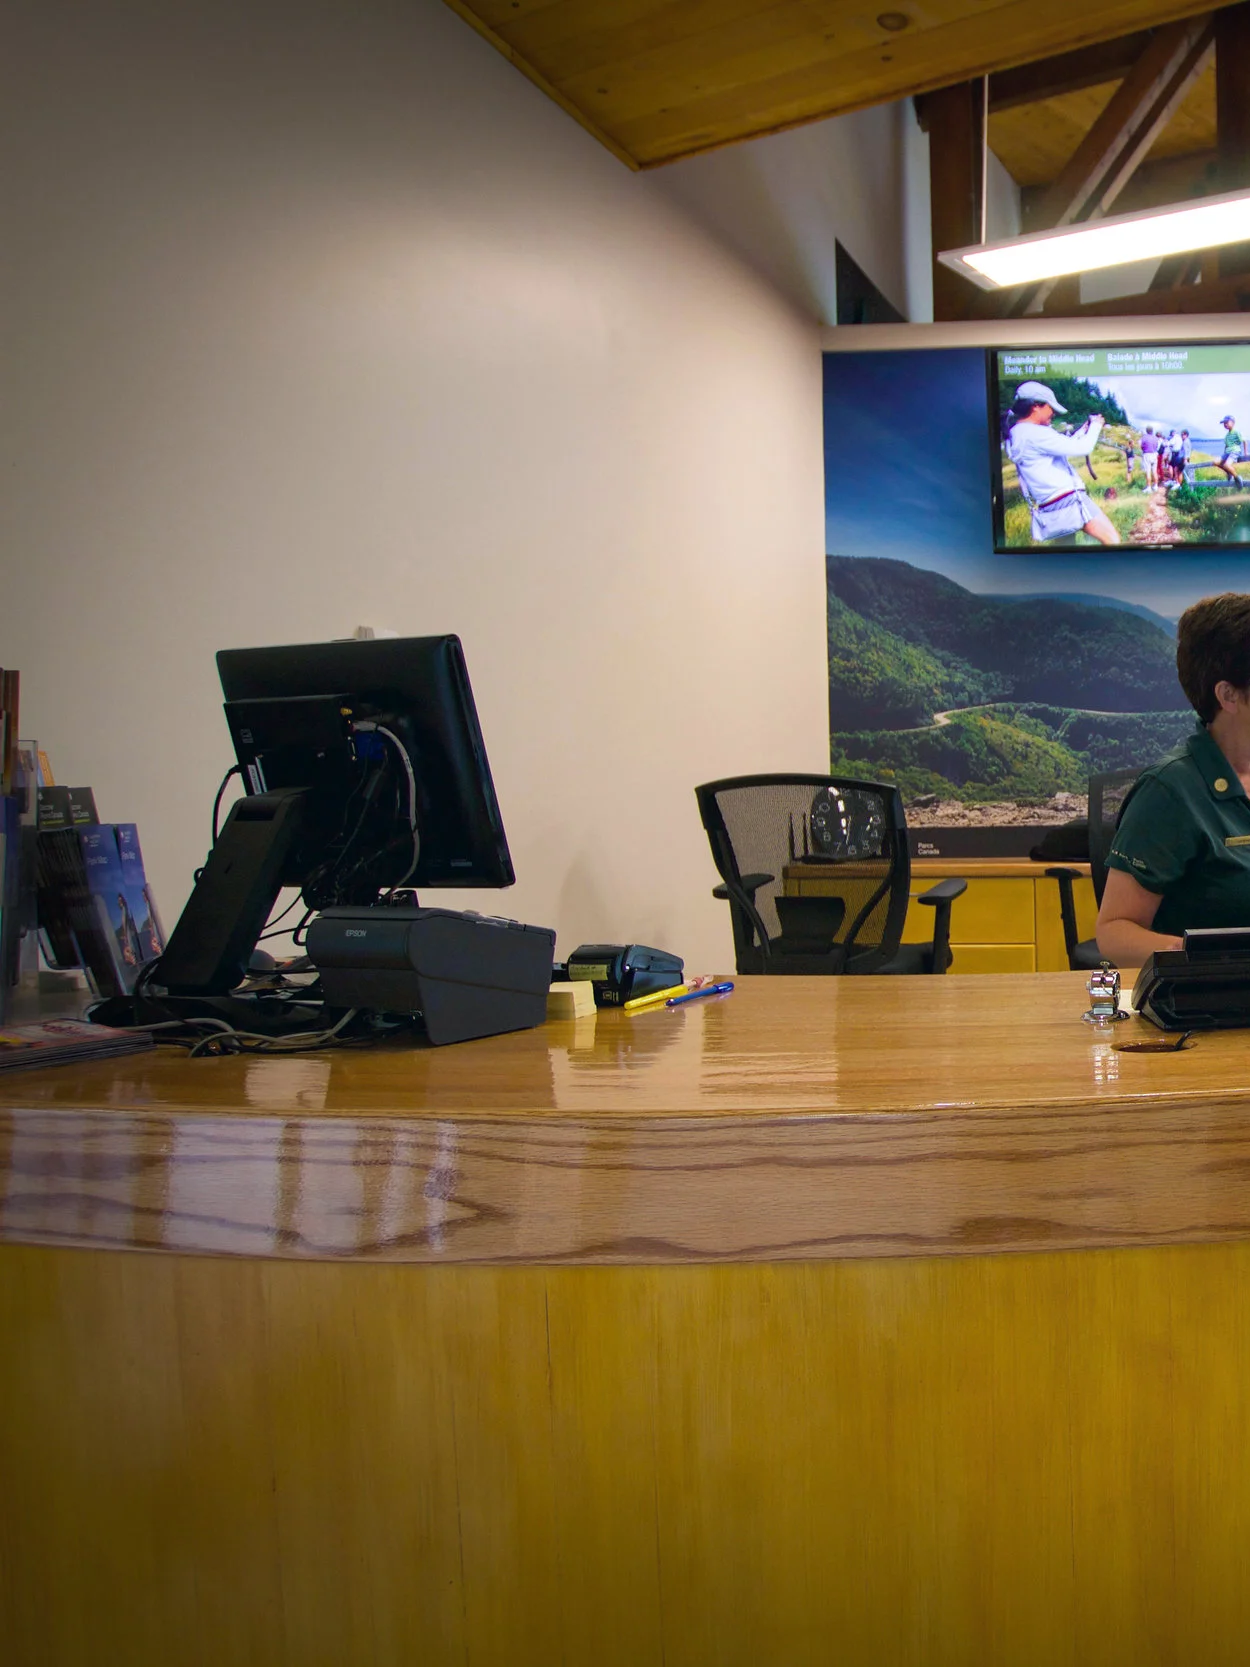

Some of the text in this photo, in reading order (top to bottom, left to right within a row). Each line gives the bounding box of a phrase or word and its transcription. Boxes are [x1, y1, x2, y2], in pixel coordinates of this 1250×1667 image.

[1141, 352, 1167, 360] Middle
[1024, 365, 1034, 374] 10
[1035, 366, 1046, 374] am
[345, 929, 367, 937] EPSON
